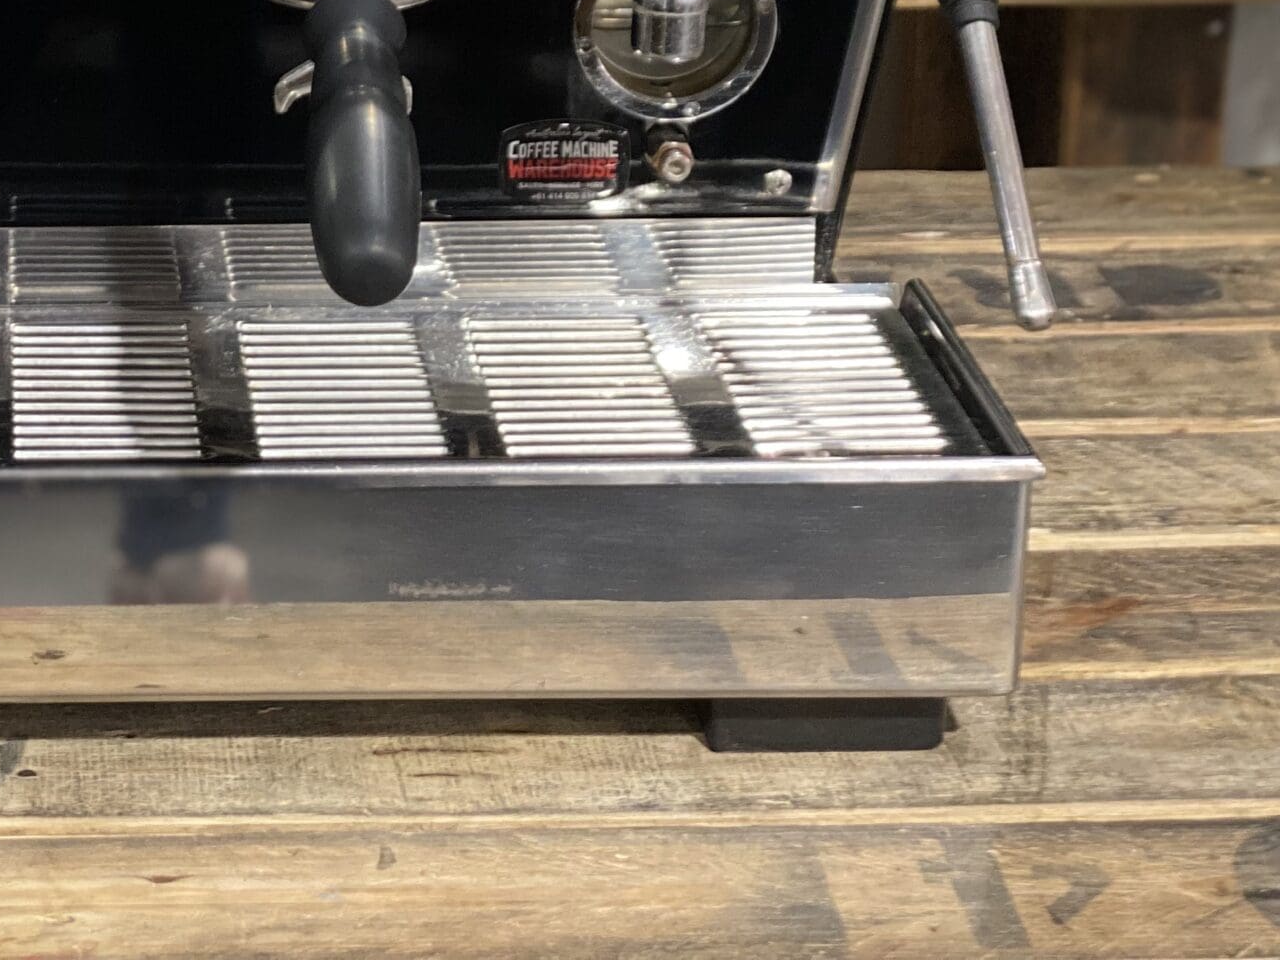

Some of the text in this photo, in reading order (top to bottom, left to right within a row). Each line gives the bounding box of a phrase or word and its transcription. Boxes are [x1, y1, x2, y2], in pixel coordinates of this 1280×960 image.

[507, 139, 620, 159] COFFEE MACHINE
[507, 158, 618, 179] WAREHOUSE
